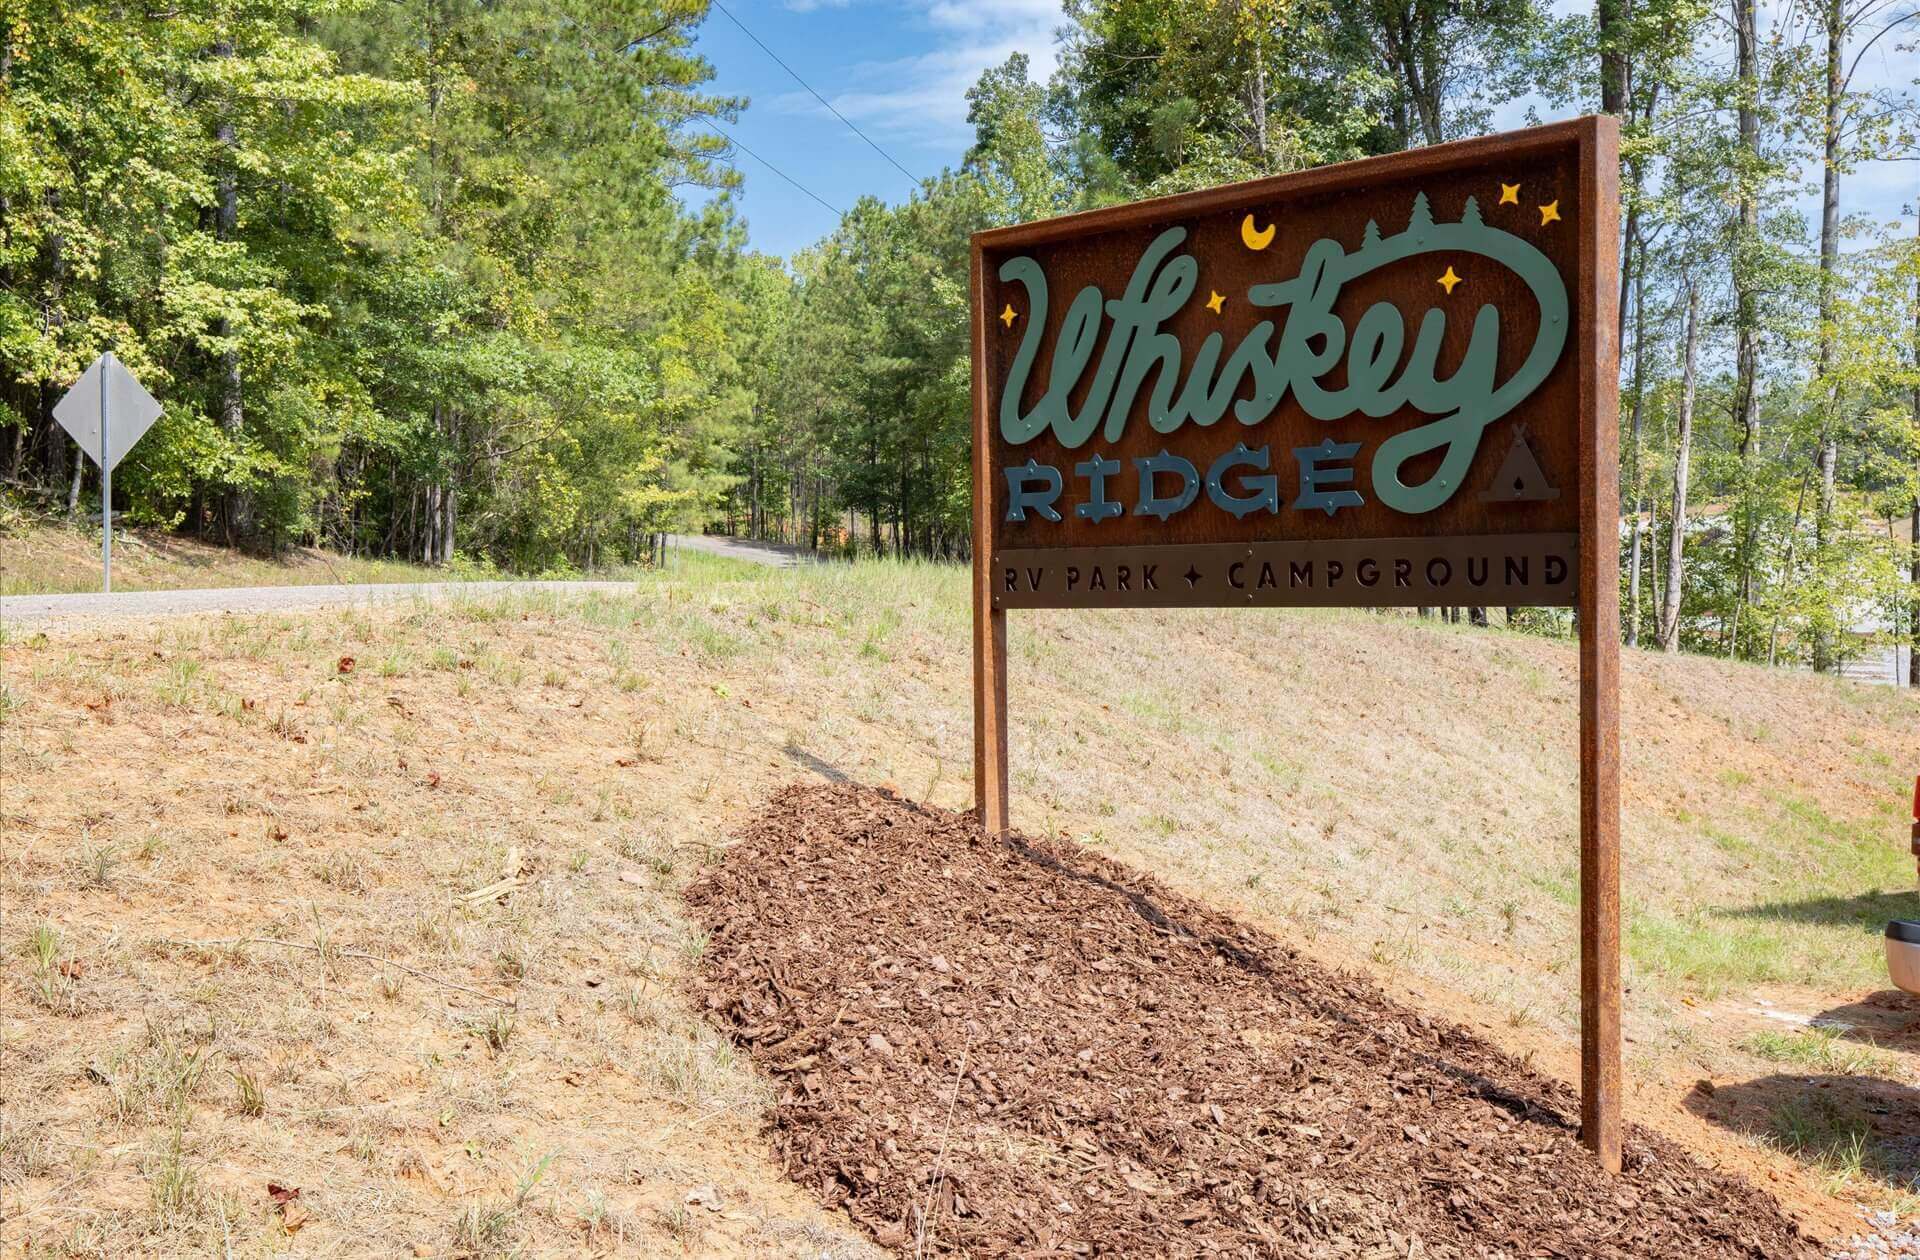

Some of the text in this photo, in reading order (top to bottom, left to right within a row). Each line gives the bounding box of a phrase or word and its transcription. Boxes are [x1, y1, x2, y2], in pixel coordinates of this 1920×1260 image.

[999, 222, 1569, 513] Whiskey
[1004, 438, 1365, 523] RIDGE
[1004, 555, 1569, 592] RV PARK CAMPGROUND
